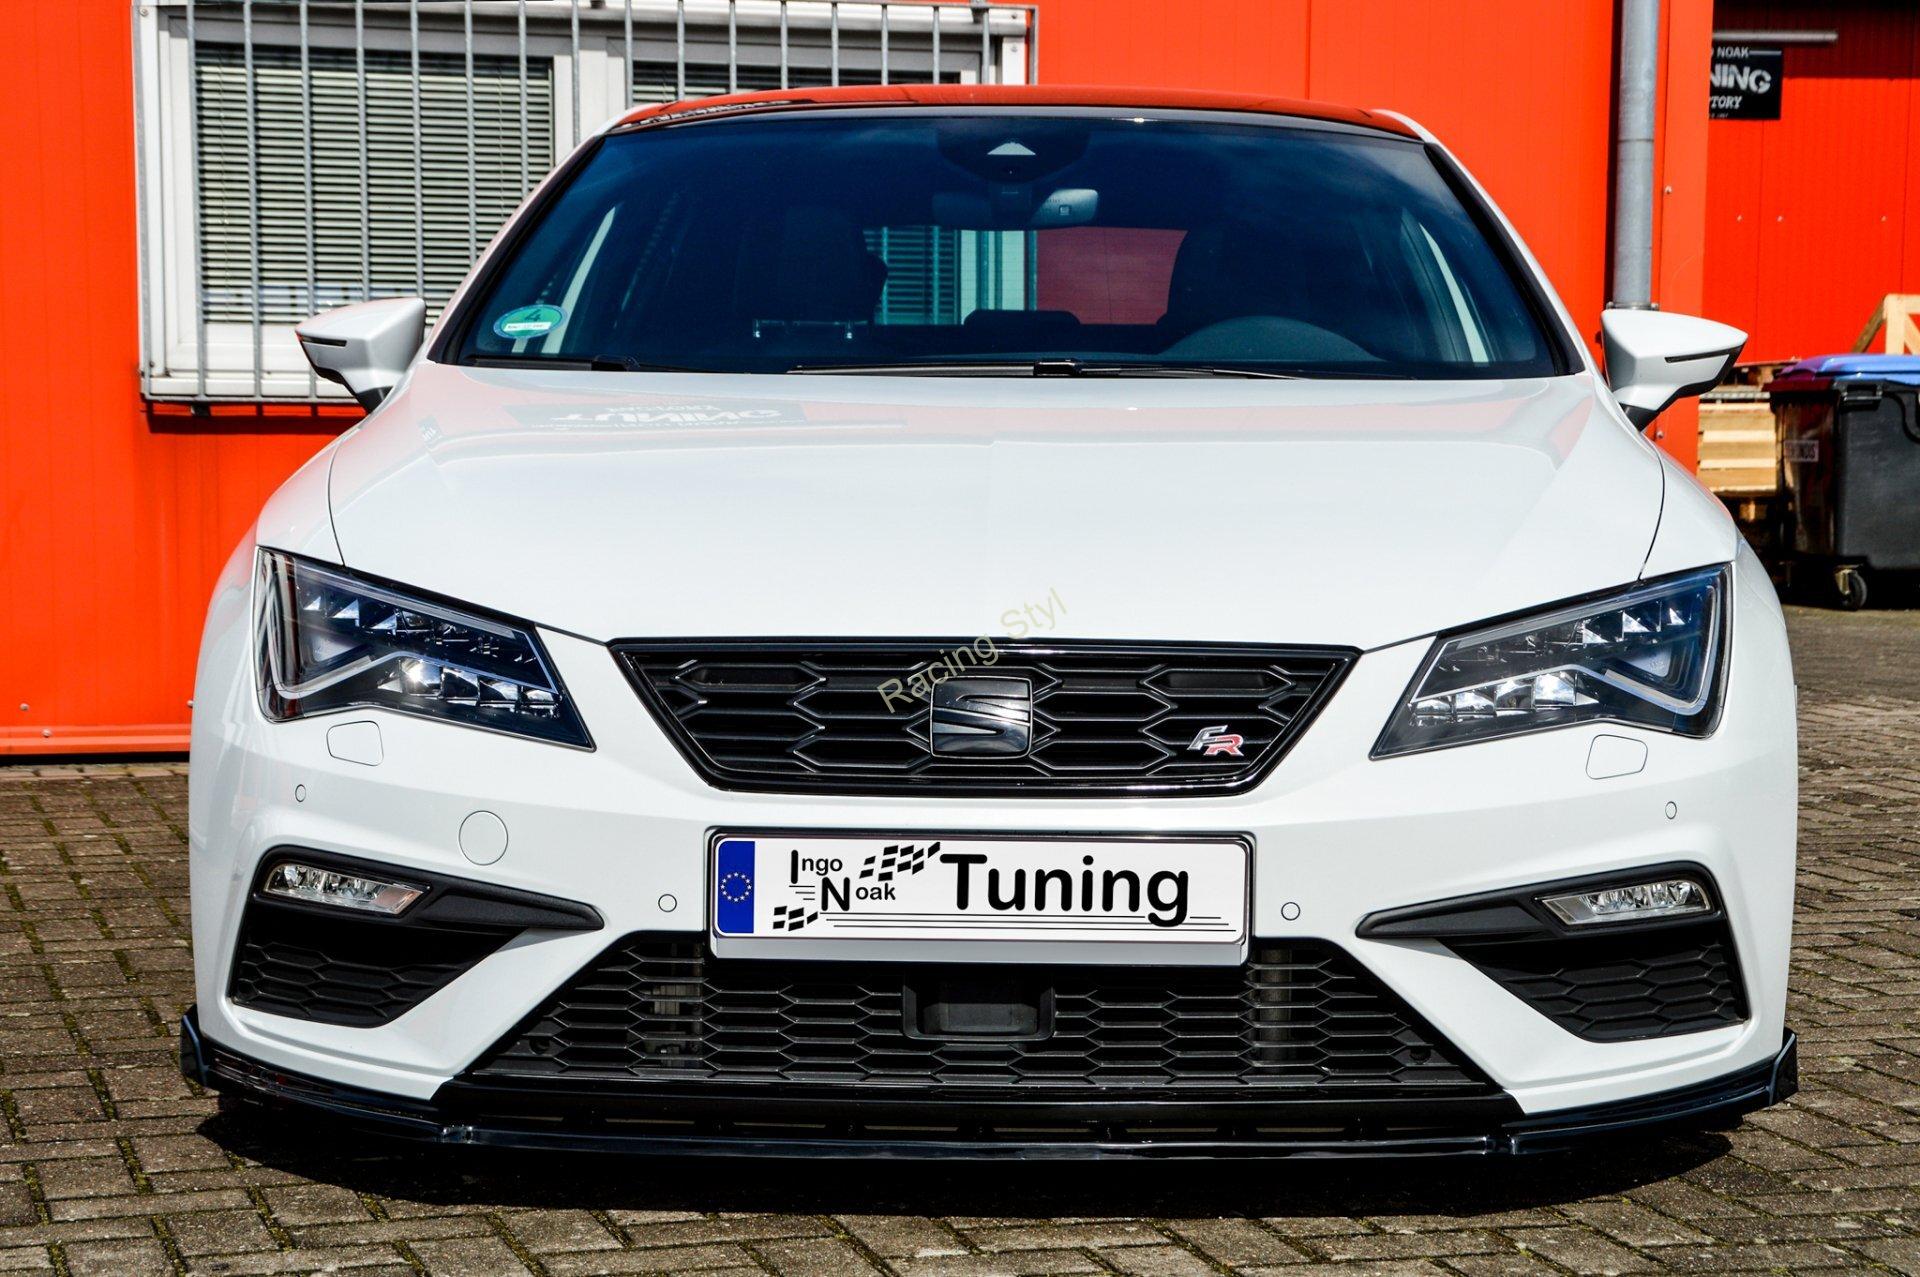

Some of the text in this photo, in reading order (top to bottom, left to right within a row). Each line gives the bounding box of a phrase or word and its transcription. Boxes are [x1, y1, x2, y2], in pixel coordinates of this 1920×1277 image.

[1717, 46, 1749, 59] NOAK
[1186, 724, 1244, 756] FR
[791, 849, 843, 885] Ingo
[820, 877, 896, 912] Noak
[940, 853, 1189, 928] Tuning
